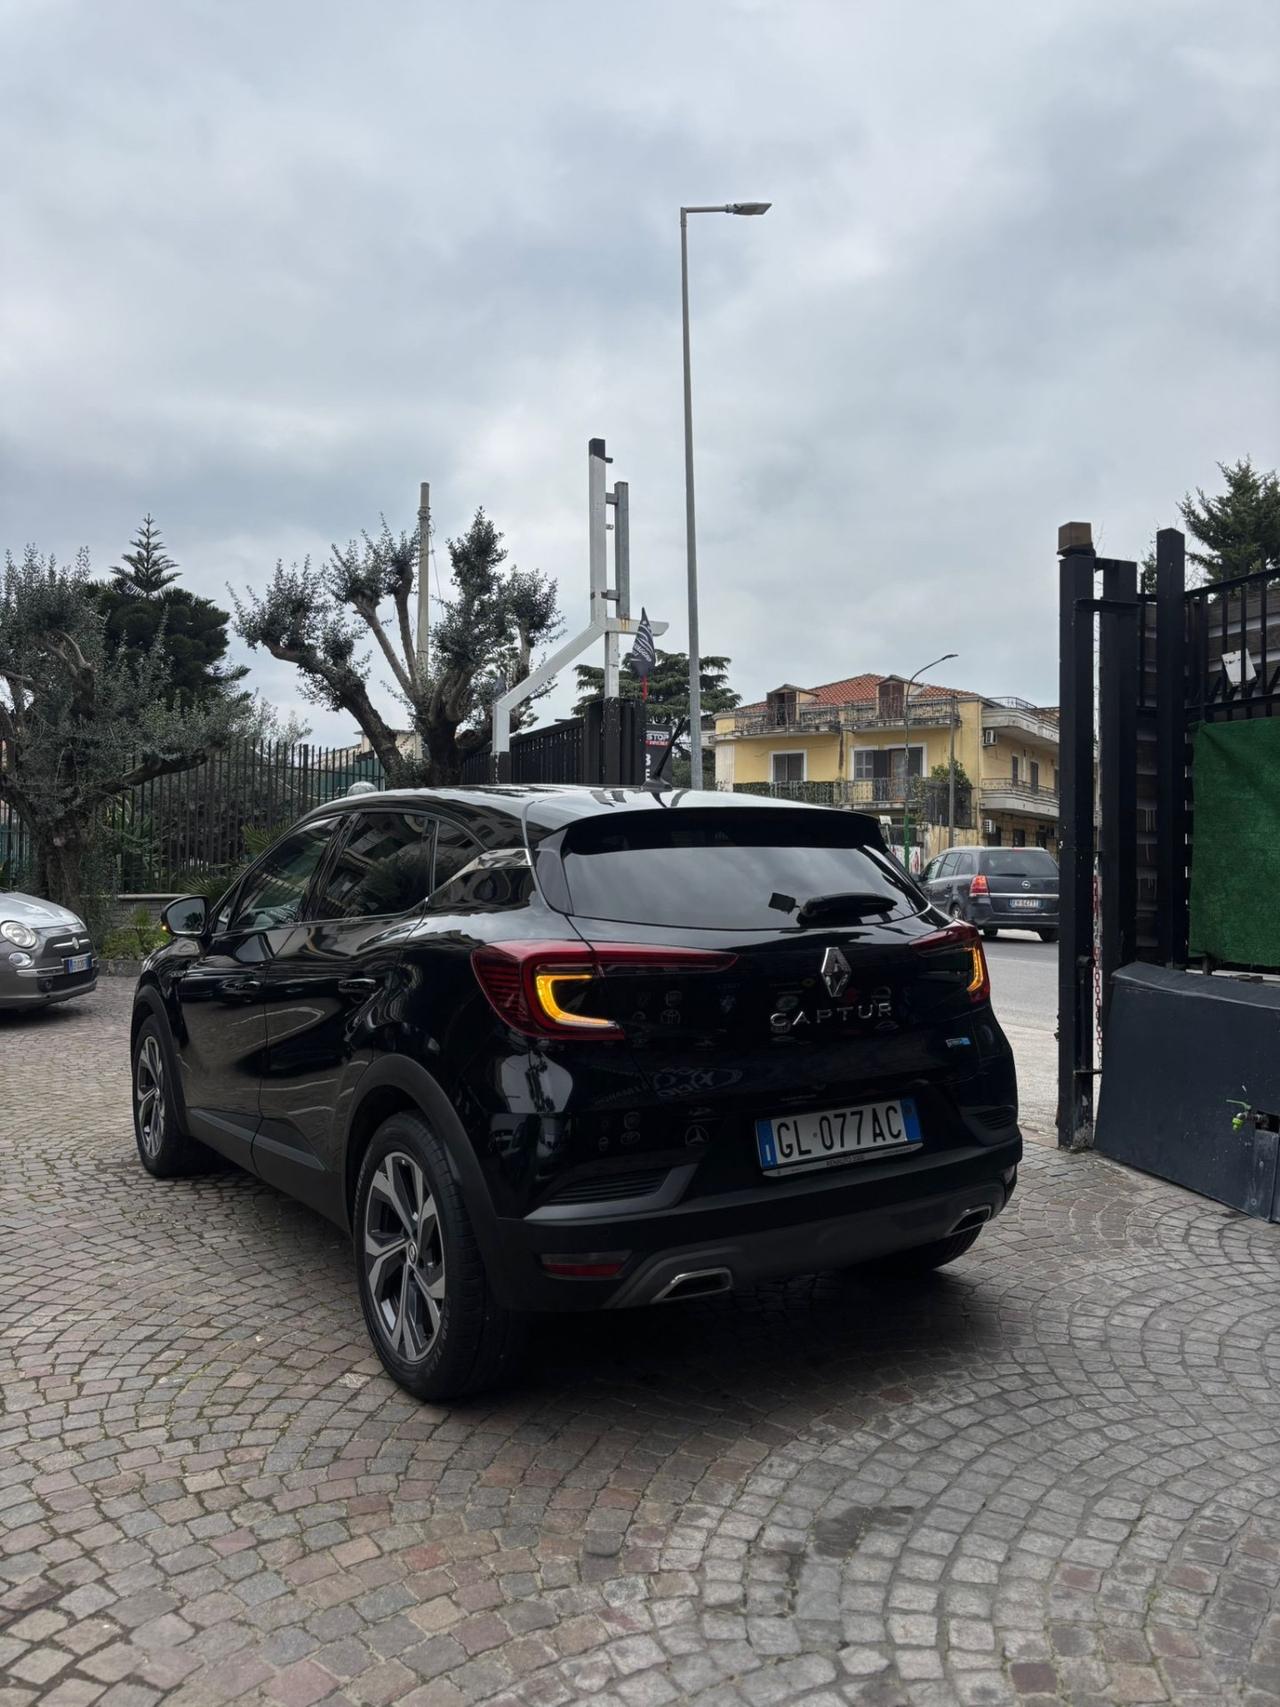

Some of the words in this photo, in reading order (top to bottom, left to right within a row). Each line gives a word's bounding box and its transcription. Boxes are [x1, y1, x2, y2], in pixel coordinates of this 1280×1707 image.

[646, 733, 669, 741] STOP
[770, 1003, 891, 1026] CAPTUR
[777, 1122, 811, 1158] GL
